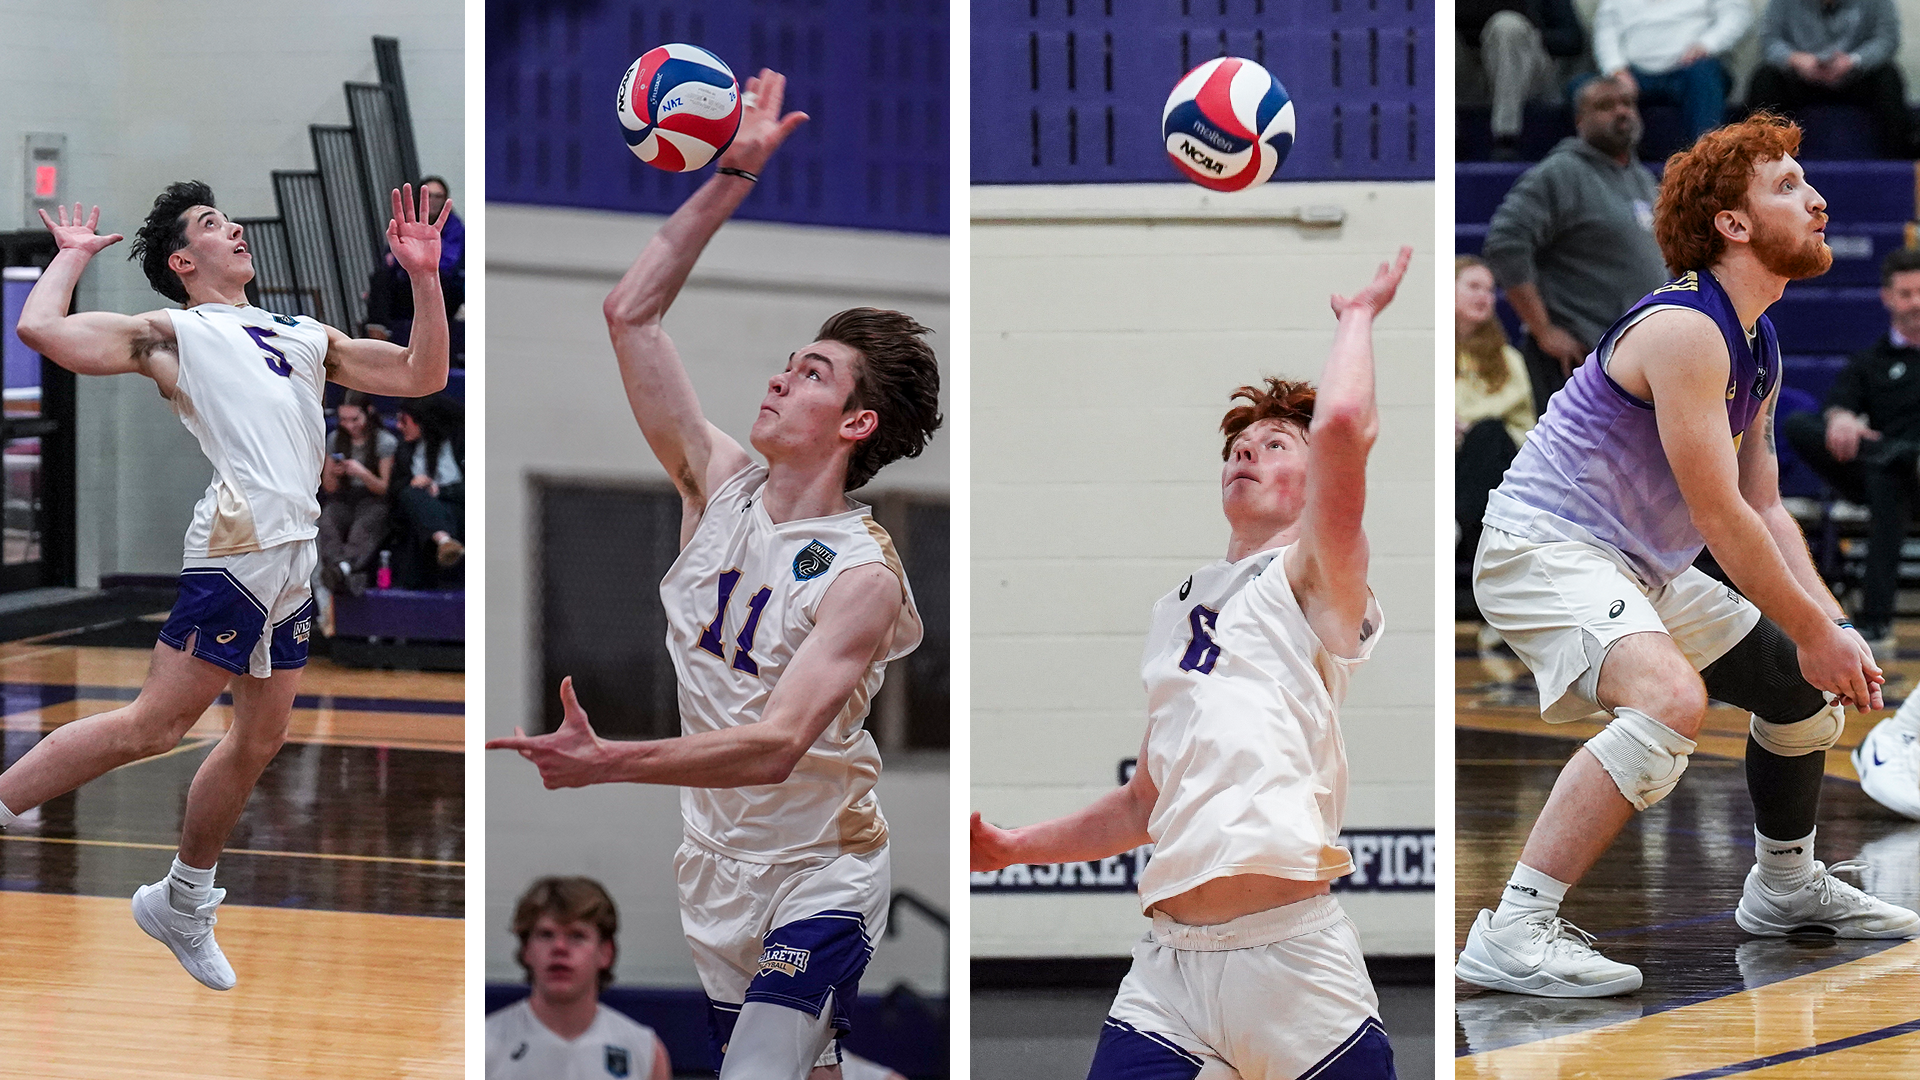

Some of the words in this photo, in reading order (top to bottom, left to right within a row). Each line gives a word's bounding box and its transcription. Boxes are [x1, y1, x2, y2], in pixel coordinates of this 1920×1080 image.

[619, 68, 634, 112] NCAA
[662, 97, 683, 112] NAZ
[1180, 140, 1224, 175] NCAA
[1193, 119, 1233, 152] molten
[242, 325, 294, 379] 5
[696, 566, 773, 679] 11
[1179, 603, 1221, 676] 6
